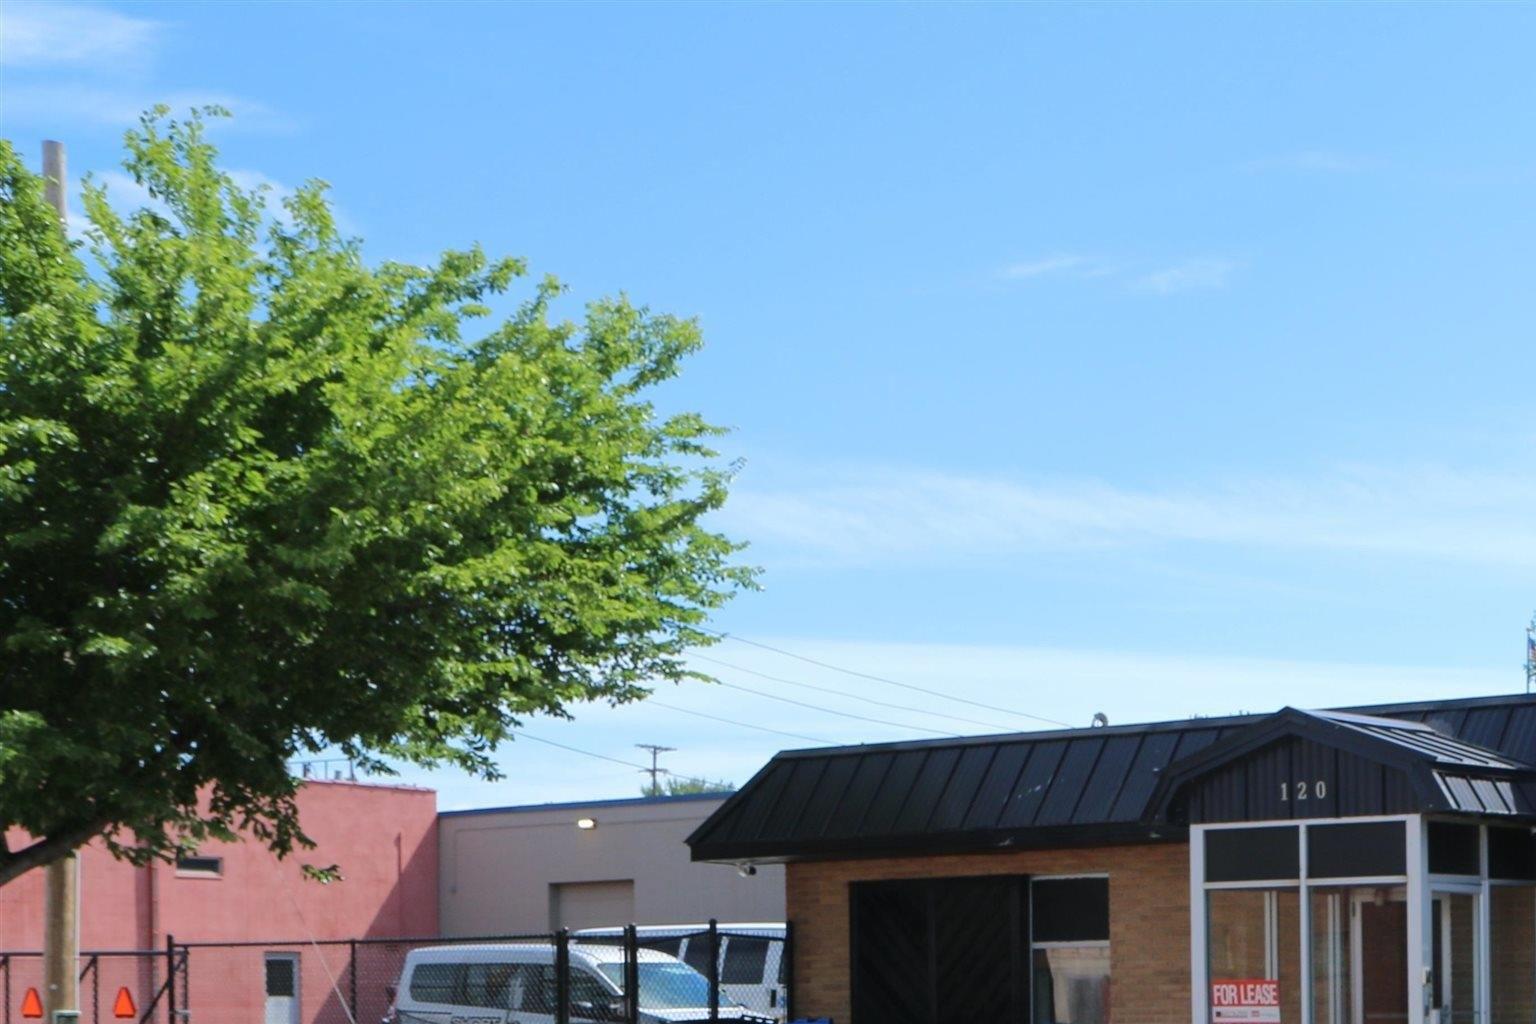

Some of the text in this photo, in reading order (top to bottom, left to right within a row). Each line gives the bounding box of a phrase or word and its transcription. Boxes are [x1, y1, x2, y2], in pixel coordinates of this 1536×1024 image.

[1280, 780, 1327, 801] 120
[1213, 984, 1278, 1005] FOR LEASE
